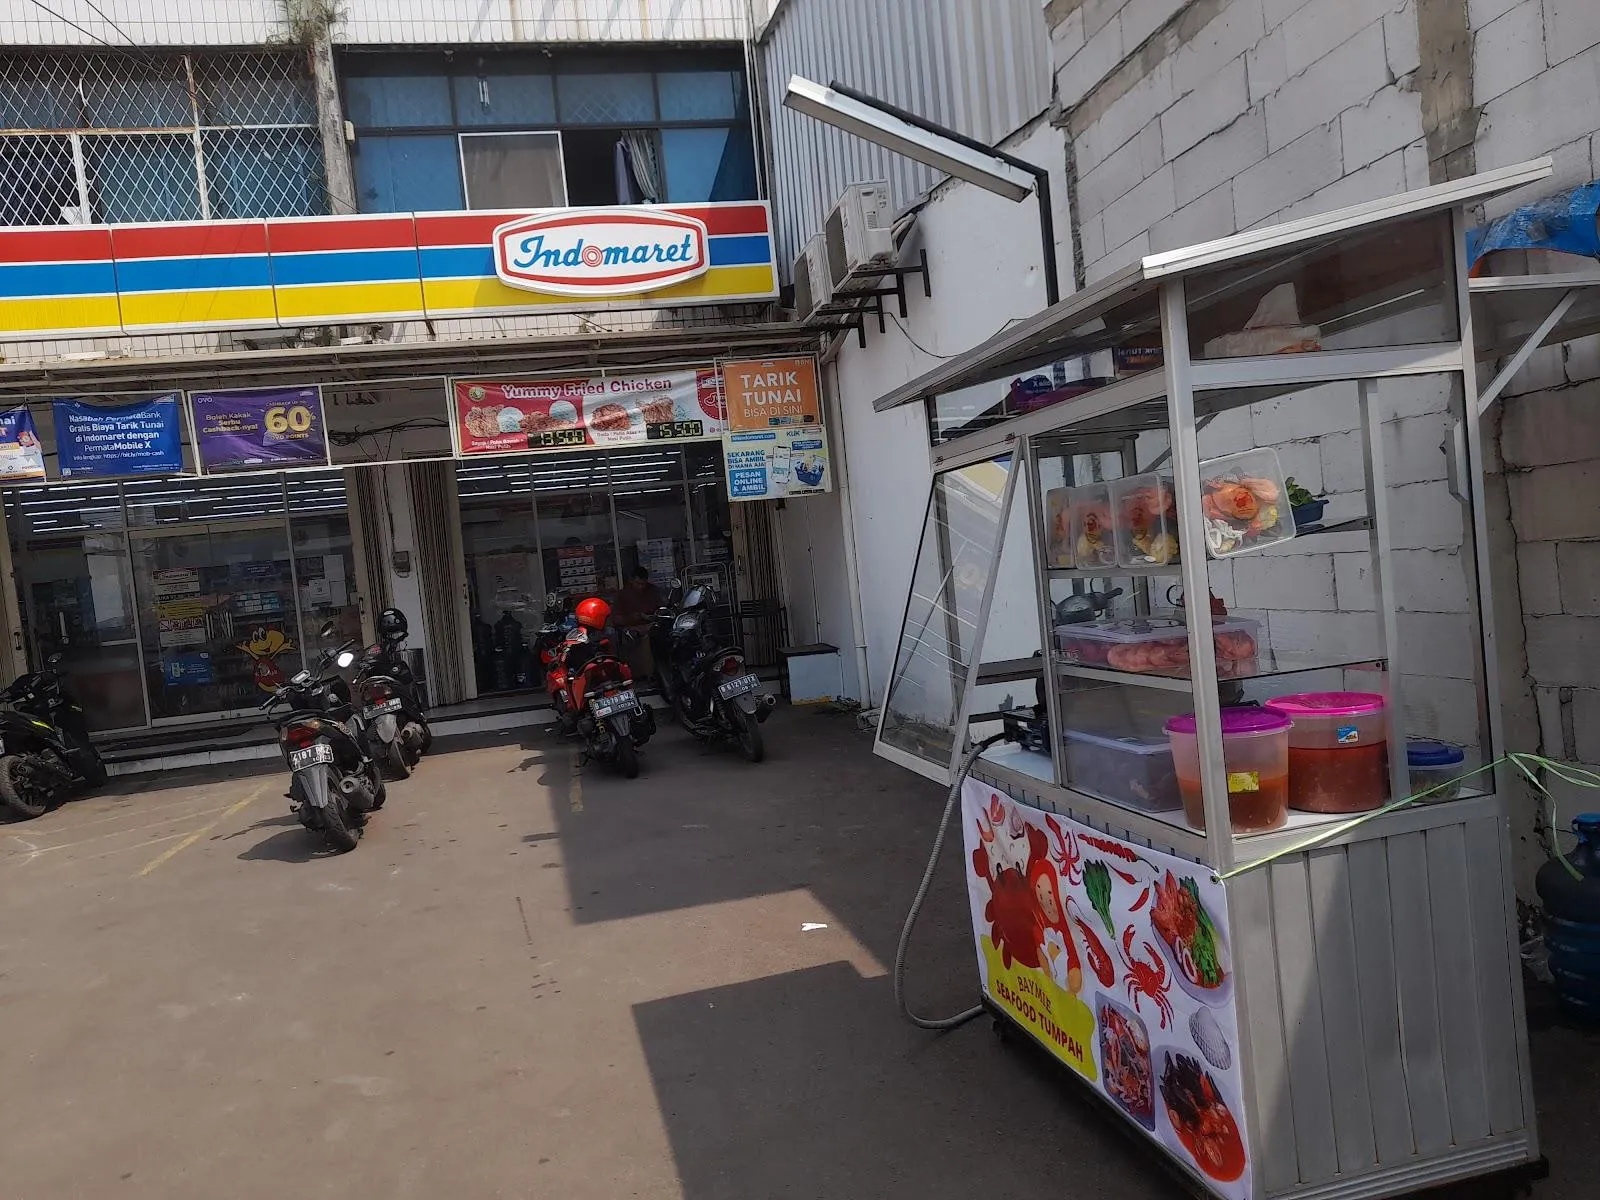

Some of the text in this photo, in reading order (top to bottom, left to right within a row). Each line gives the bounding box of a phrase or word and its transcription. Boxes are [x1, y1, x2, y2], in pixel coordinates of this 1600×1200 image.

[513, 234, 693, 268] Indomaret
[740, 371, 798, 389] TARIK
[501, 378, 673, 399] Yummy Fried Chicken
[742, 388, 801, 406] TUNAI
[68, 411, 162, 423] Nasabah PermataBank
[744, 405, 803, 418] BISA DI SINI
[69, 420, 164, 433] Gratis Biaya Tarik Tunai
[75, 431, 160, 443] di Indomaret dengan
[84, 442, 143, 452] PermataMobile
[727, 450, 765, 458] SEKARANG
[1017, 976, 1052, 1014] BAYMIE
[996, 979, 1083, 1062] SEAFOOD TUMPAH
